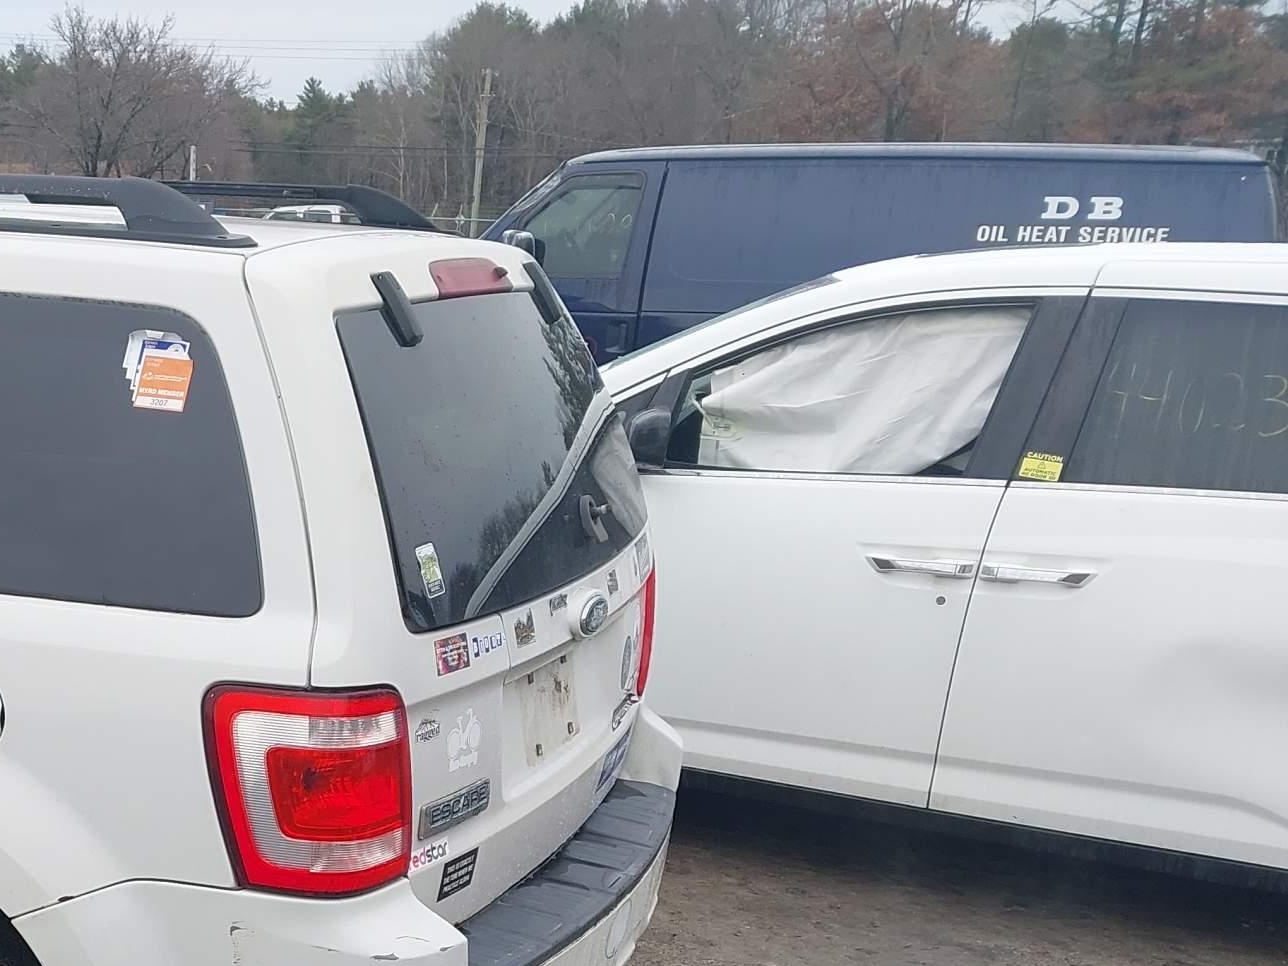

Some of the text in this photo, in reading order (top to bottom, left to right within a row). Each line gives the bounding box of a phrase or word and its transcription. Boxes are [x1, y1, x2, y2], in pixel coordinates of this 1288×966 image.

[976, 225, 1171, 244] OIL HEAT SERVICE
[1027, 451, 1064, 463] CAUTION
[429, 784, 489, 827] ESCAPE
